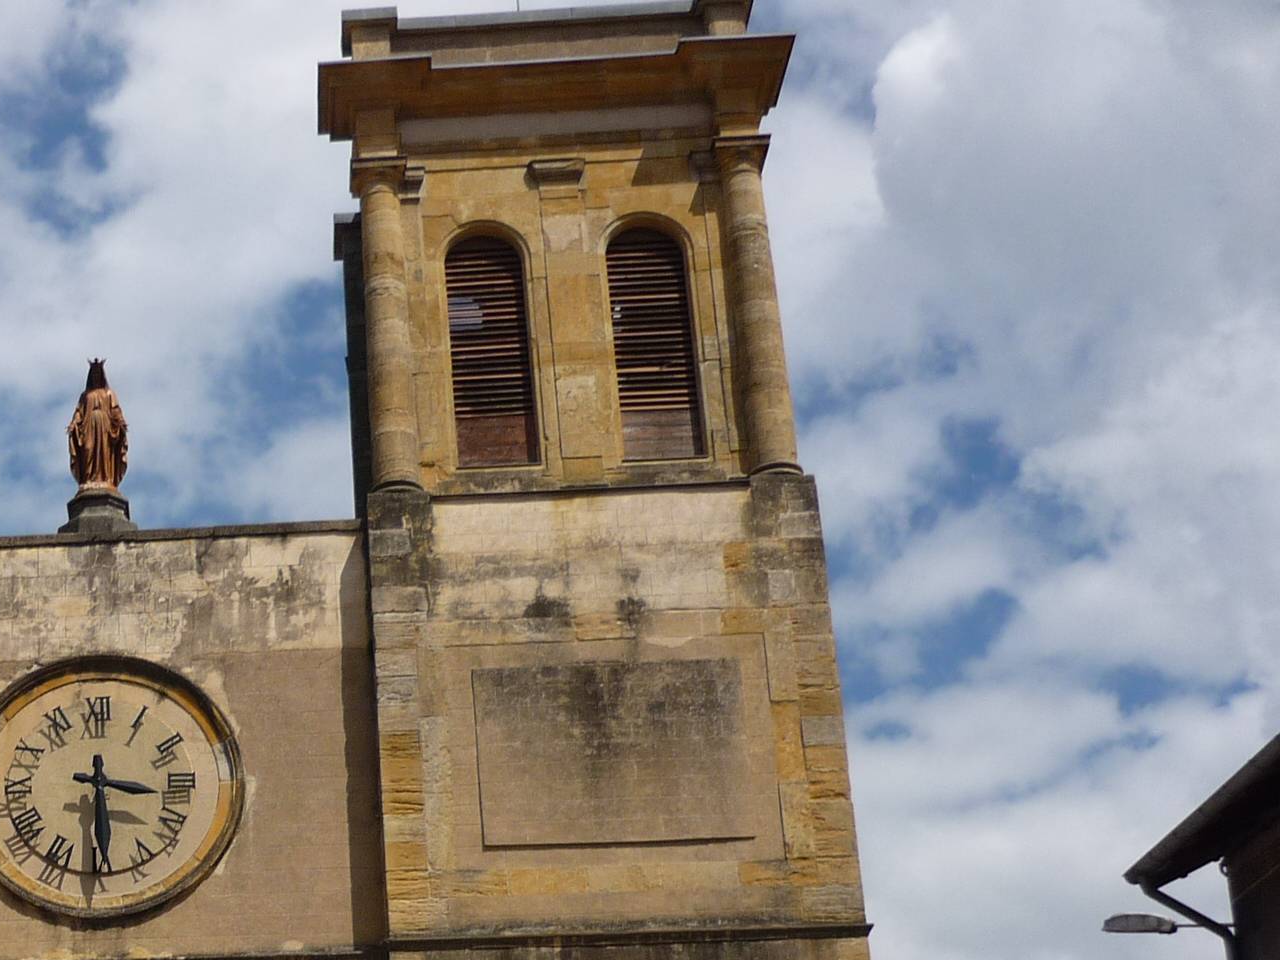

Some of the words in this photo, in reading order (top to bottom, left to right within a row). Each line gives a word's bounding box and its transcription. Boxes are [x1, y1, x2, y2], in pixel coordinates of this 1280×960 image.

[42, 706, 73, 733] XI
[86, 696, 112, 721] XII
[15, 737, 46, 762] X
[155, 731, 185, 755] II
[4, 776, 32, 796] IX
[167, 771, 196, 790] III
[158, 806, 188, 835] IV
